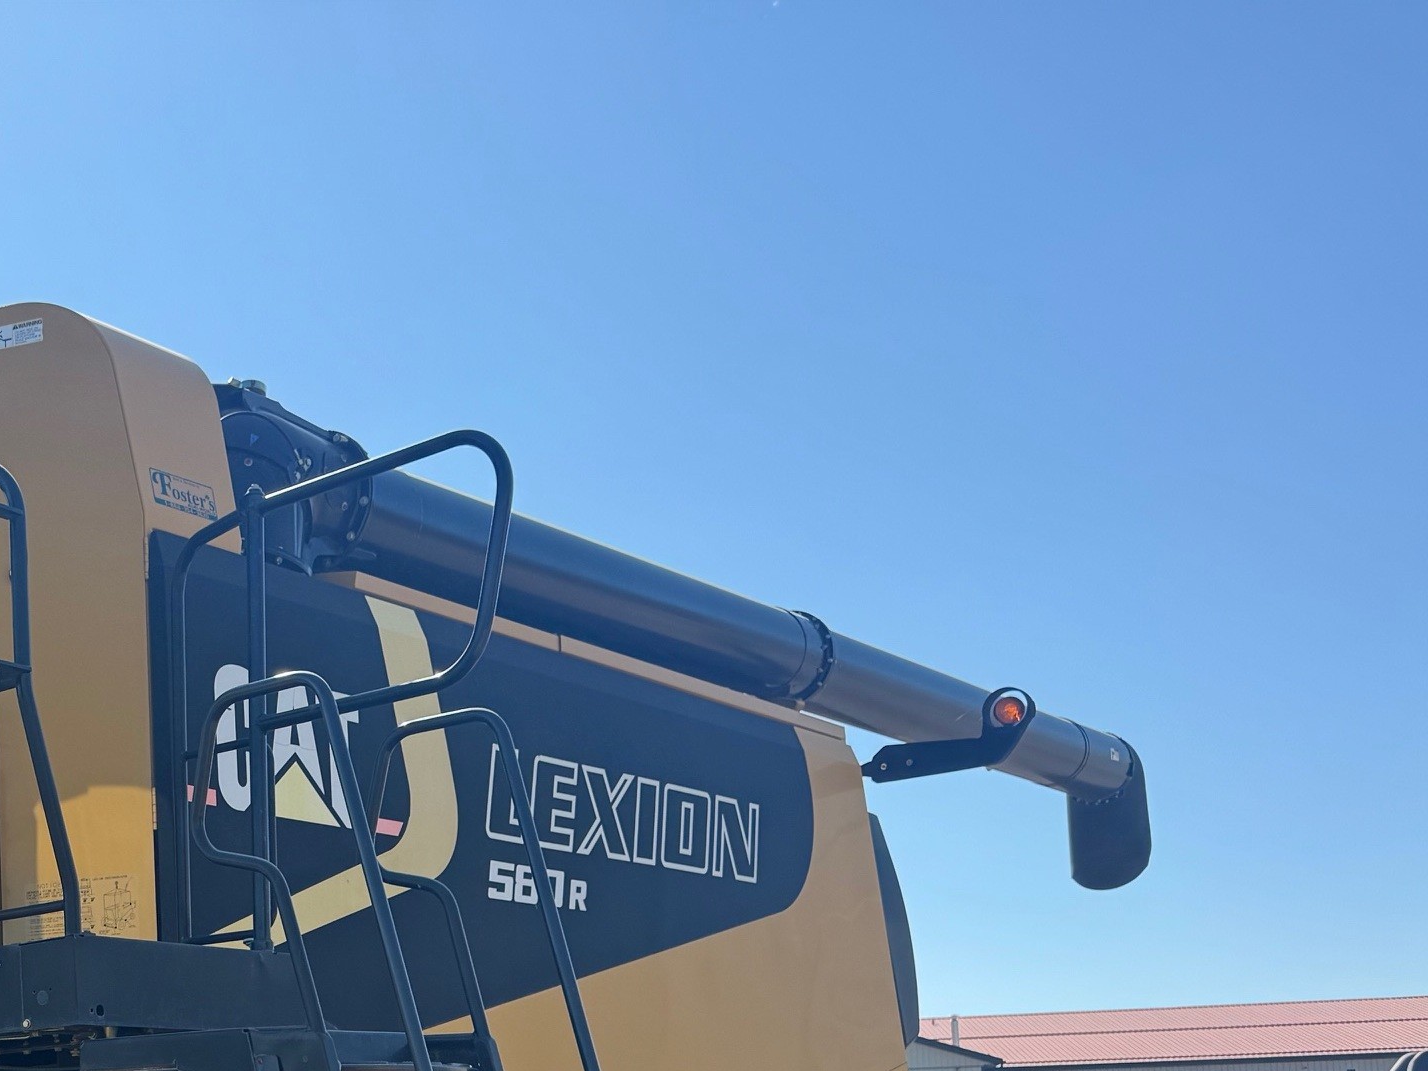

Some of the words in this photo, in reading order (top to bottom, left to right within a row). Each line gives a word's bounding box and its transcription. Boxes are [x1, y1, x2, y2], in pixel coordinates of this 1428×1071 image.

[18, 319, 43, 329] WARNING
[152, 472, 215, 511] Foster's
[486, 743, 760, 884] LEXION
